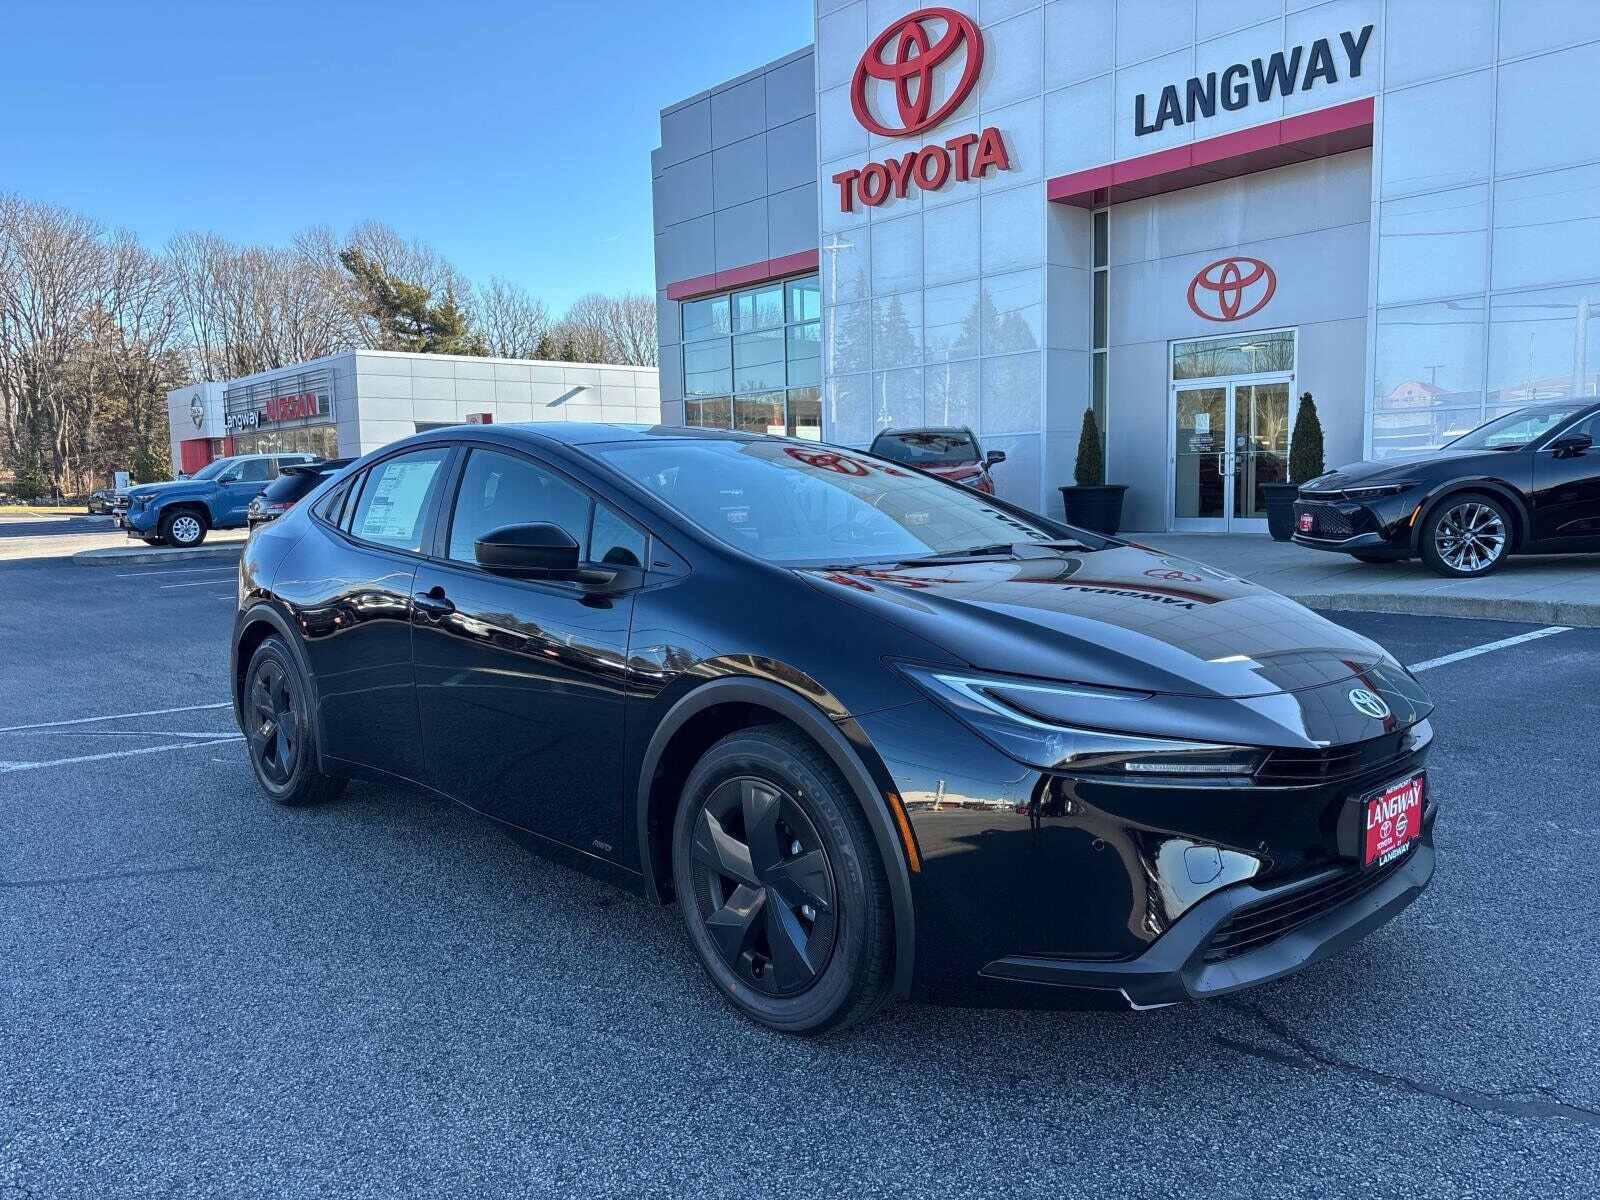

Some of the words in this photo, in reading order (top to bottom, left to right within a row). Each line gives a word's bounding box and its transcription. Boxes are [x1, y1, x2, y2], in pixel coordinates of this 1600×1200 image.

[1133, 24, 1375, 138] LANGWAY
[832, 126, 1009, 213] TOYOTA
[224, 410, 261, 430] Langway
[266, 391, 320, 422] NISSAN
[1367, 785, 1421, 830] LANGWAY
[1379, 841, 1410, 866] LANGWAY
